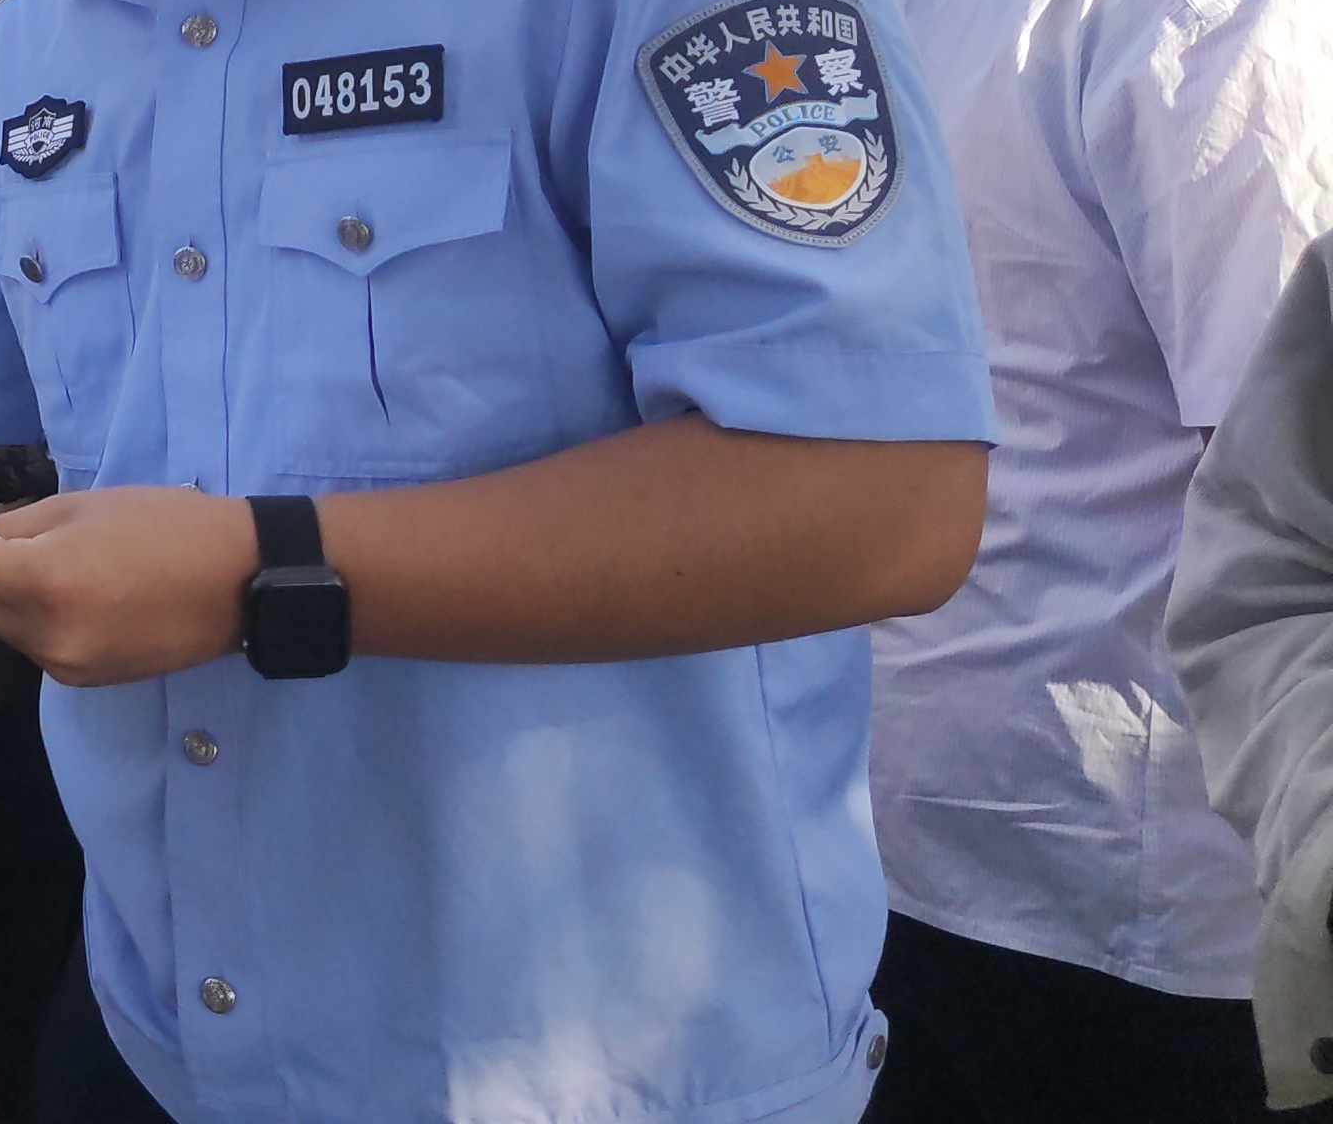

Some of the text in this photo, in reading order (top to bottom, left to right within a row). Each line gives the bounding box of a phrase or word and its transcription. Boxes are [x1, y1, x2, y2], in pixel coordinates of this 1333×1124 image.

[659, 3, 858, 85] 中华人民共和国
[291, 61, 433, 120] 048153
[683, 47, 865, 127] 警 察
[748, 103, 836, 138] POLICE
[771, 134, 843, 164] 公 安
